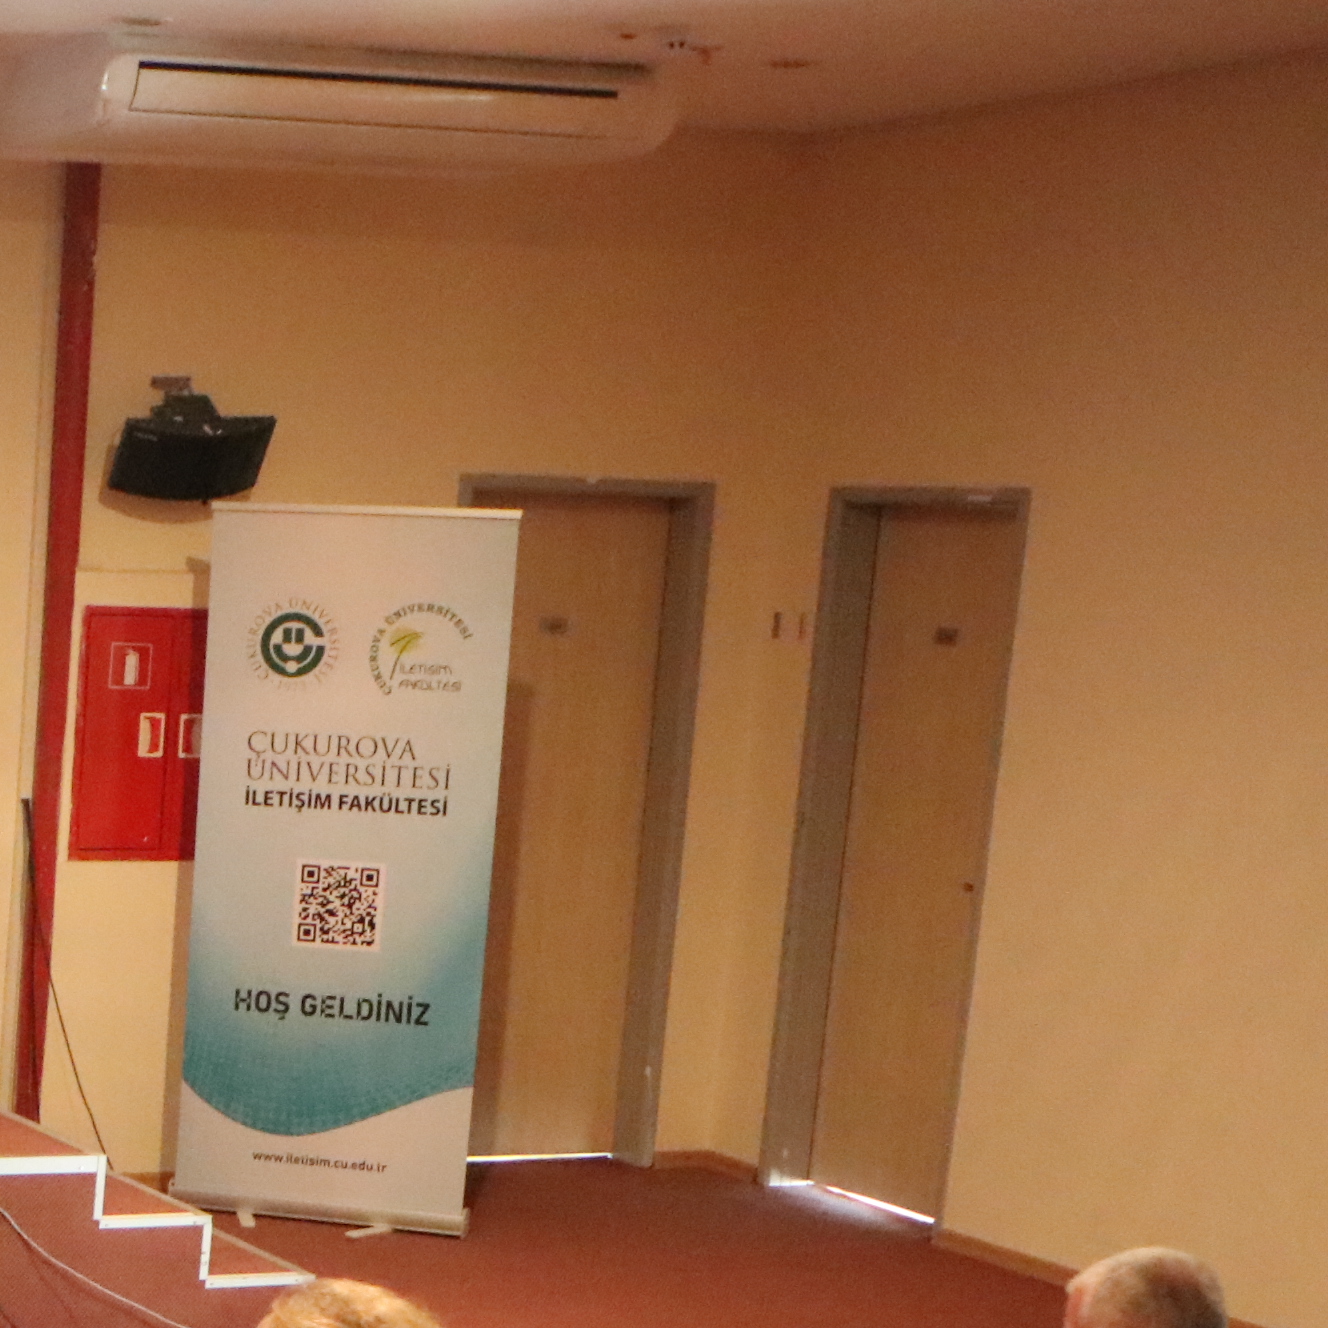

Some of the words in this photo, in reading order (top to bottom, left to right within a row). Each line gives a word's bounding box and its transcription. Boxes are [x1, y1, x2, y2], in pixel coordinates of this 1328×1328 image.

[247, 730, 417, 763] ÇUKUROVA
[246, 756, 452, 791] ÜNİVERSİTESİ
[244, 785, 332, 813] İLETİŞİM
[338, 793, 448, 817] FAKÜLTESİ
[233, 988, 291, 1021] HOŞ
[300, 992, 431, 1027] GELDİNİZ
